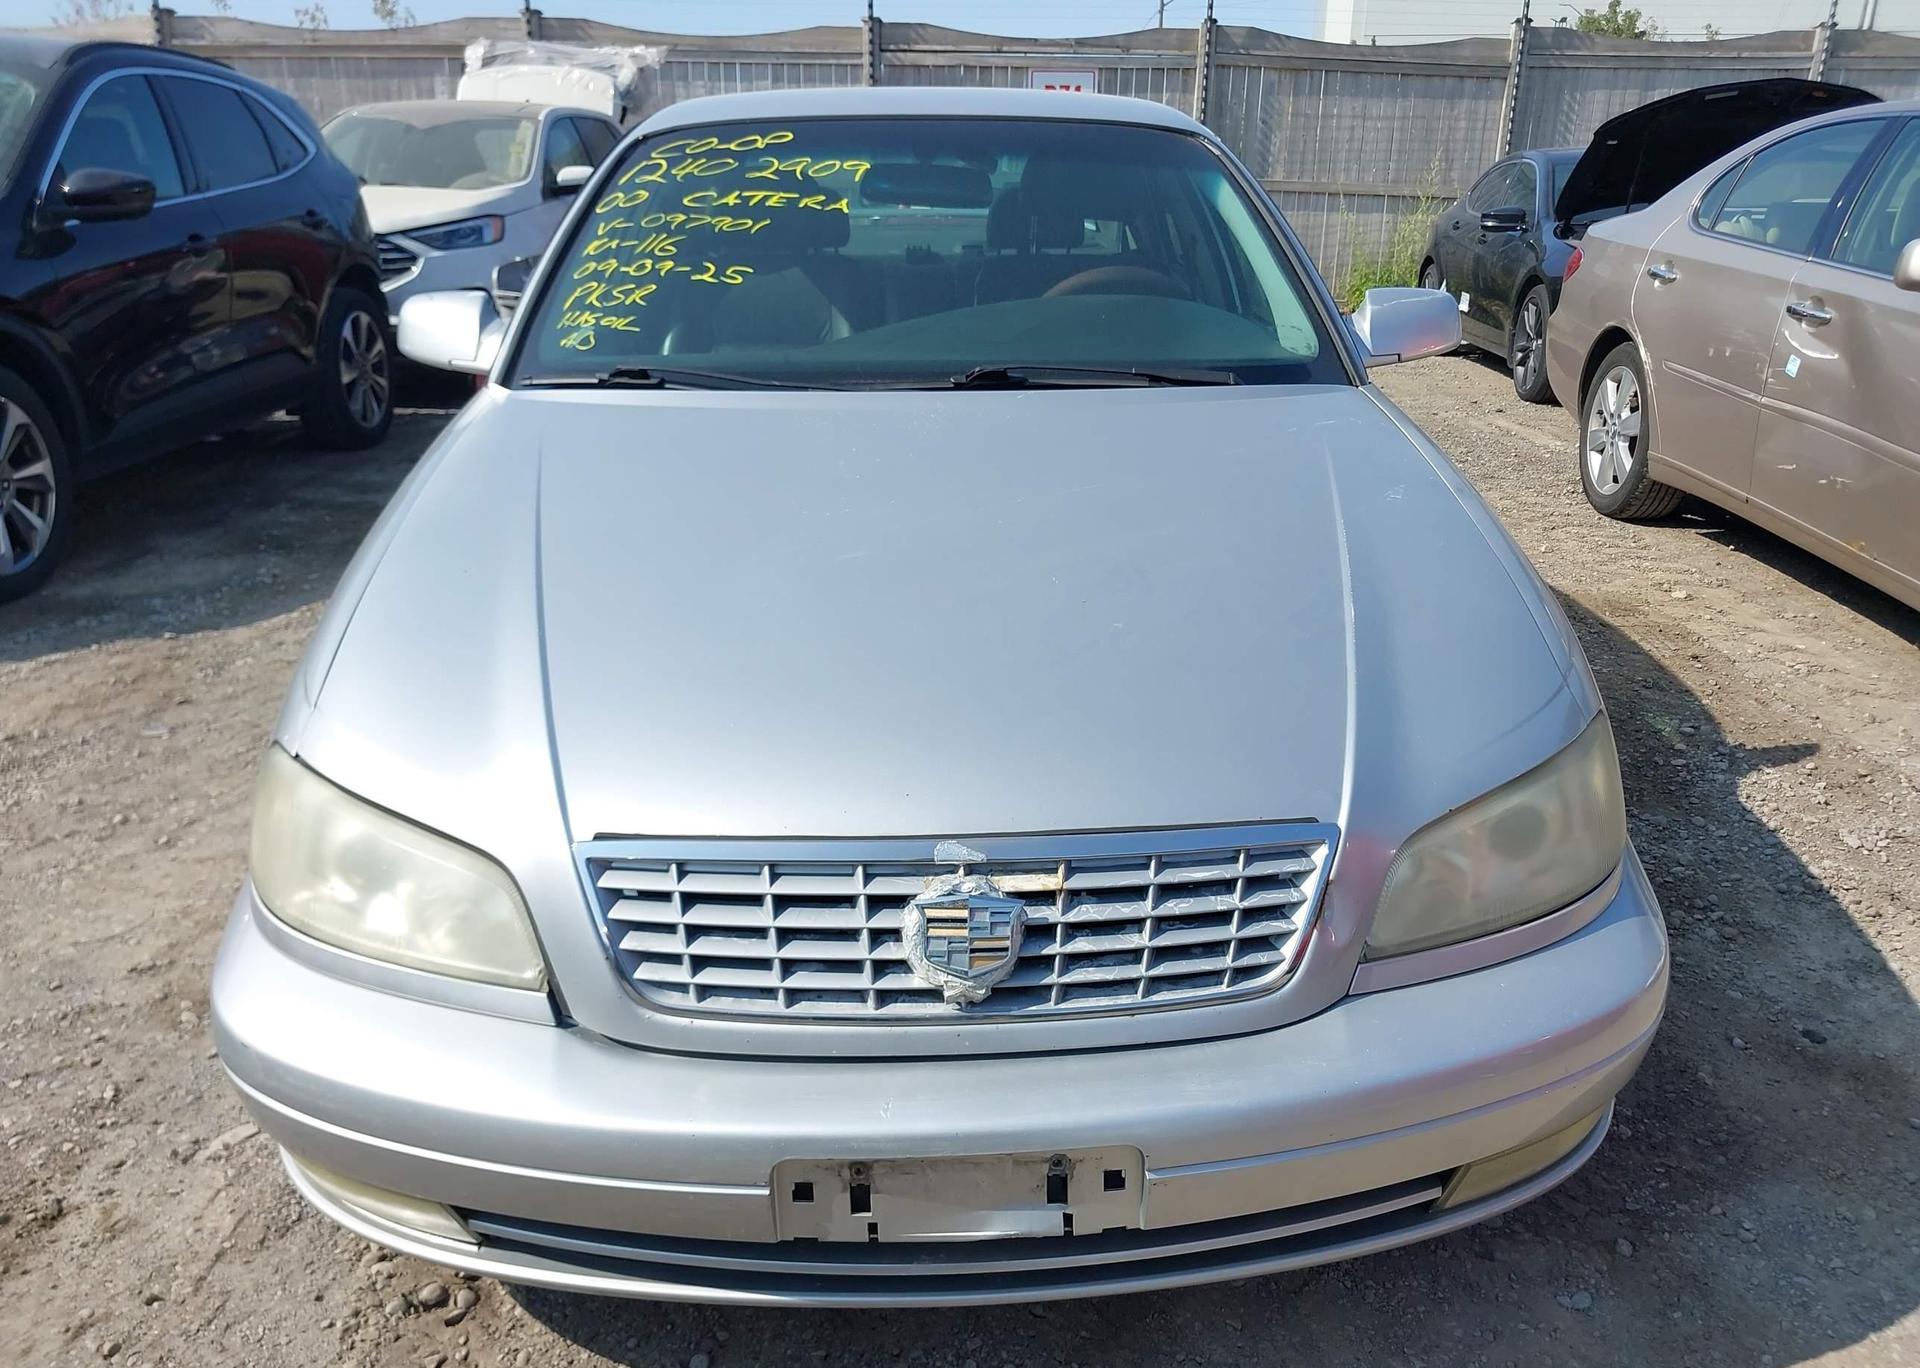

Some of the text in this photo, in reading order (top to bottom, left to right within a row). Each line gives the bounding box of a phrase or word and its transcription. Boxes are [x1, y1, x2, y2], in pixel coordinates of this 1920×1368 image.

[650, 131, 795, 159] CO-OP
[617, 157, 871, 186] 1240 2909
[595, 189, 850, 214] 00 CATERA
[572, 258, 754, 285] 09-09-25
